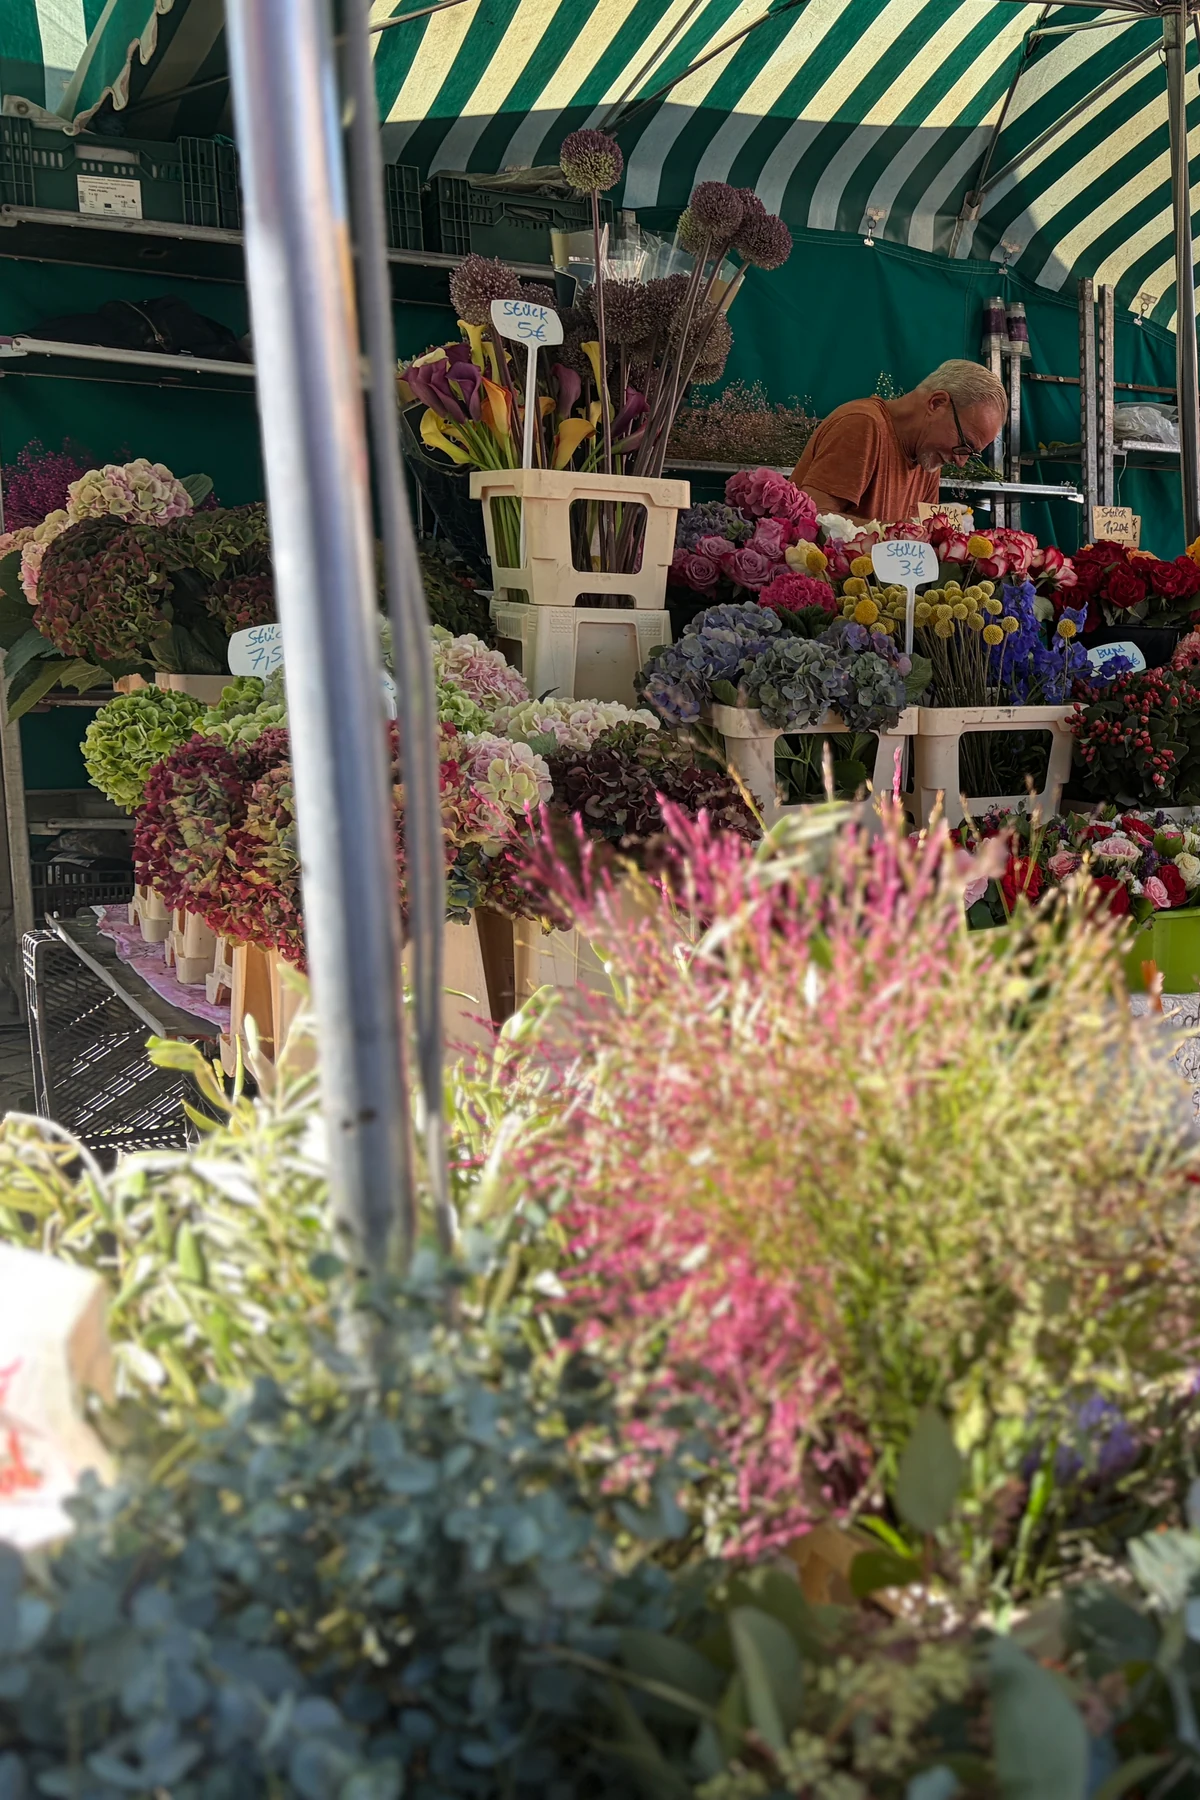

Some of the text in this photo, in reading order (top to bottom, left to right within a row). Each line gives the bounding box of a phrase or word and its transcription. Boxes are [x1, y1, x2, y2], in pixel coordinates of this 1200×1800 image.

[503, 301, 549, 325] Stück
[517, 321, 547, 342] 5€
[1101, 507, 1127, 519] Stück
[886, 542, 925, 559] Stück
[245, 626, 283, 648] Stüc
[247, 645, 284, 671] 7,5
